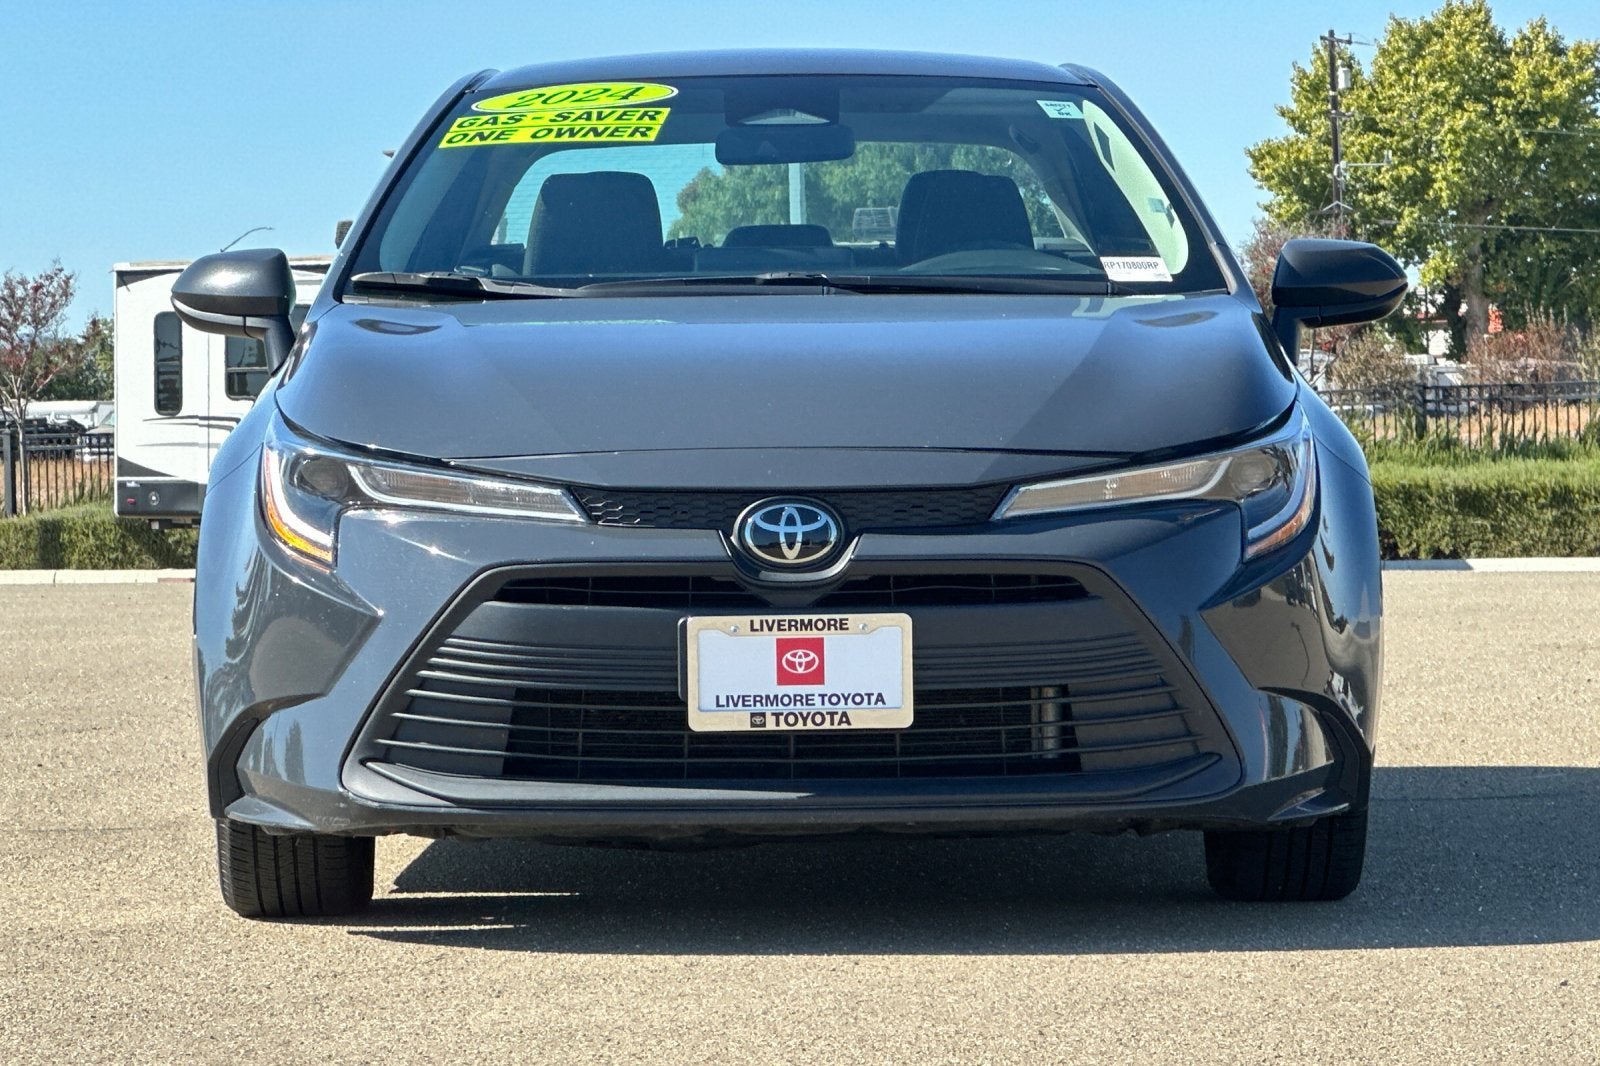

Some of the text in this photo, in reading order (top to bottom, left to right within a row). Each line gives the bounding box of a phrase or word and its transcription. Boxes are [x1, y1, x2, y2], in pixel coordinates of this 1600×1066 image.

[505, 86, 645, 109] 2024
[456, 113, 523, 129] GAS
[549, 110, 663, 123] SAVER
[446, 126, 654, 144] ONE OWNER
[750, 618, 849, 632] LIVERMORE
[715, 692, 886, 708] LIVERMORE TOYOTA
[771, 711, 852, 727] TOYOTA
